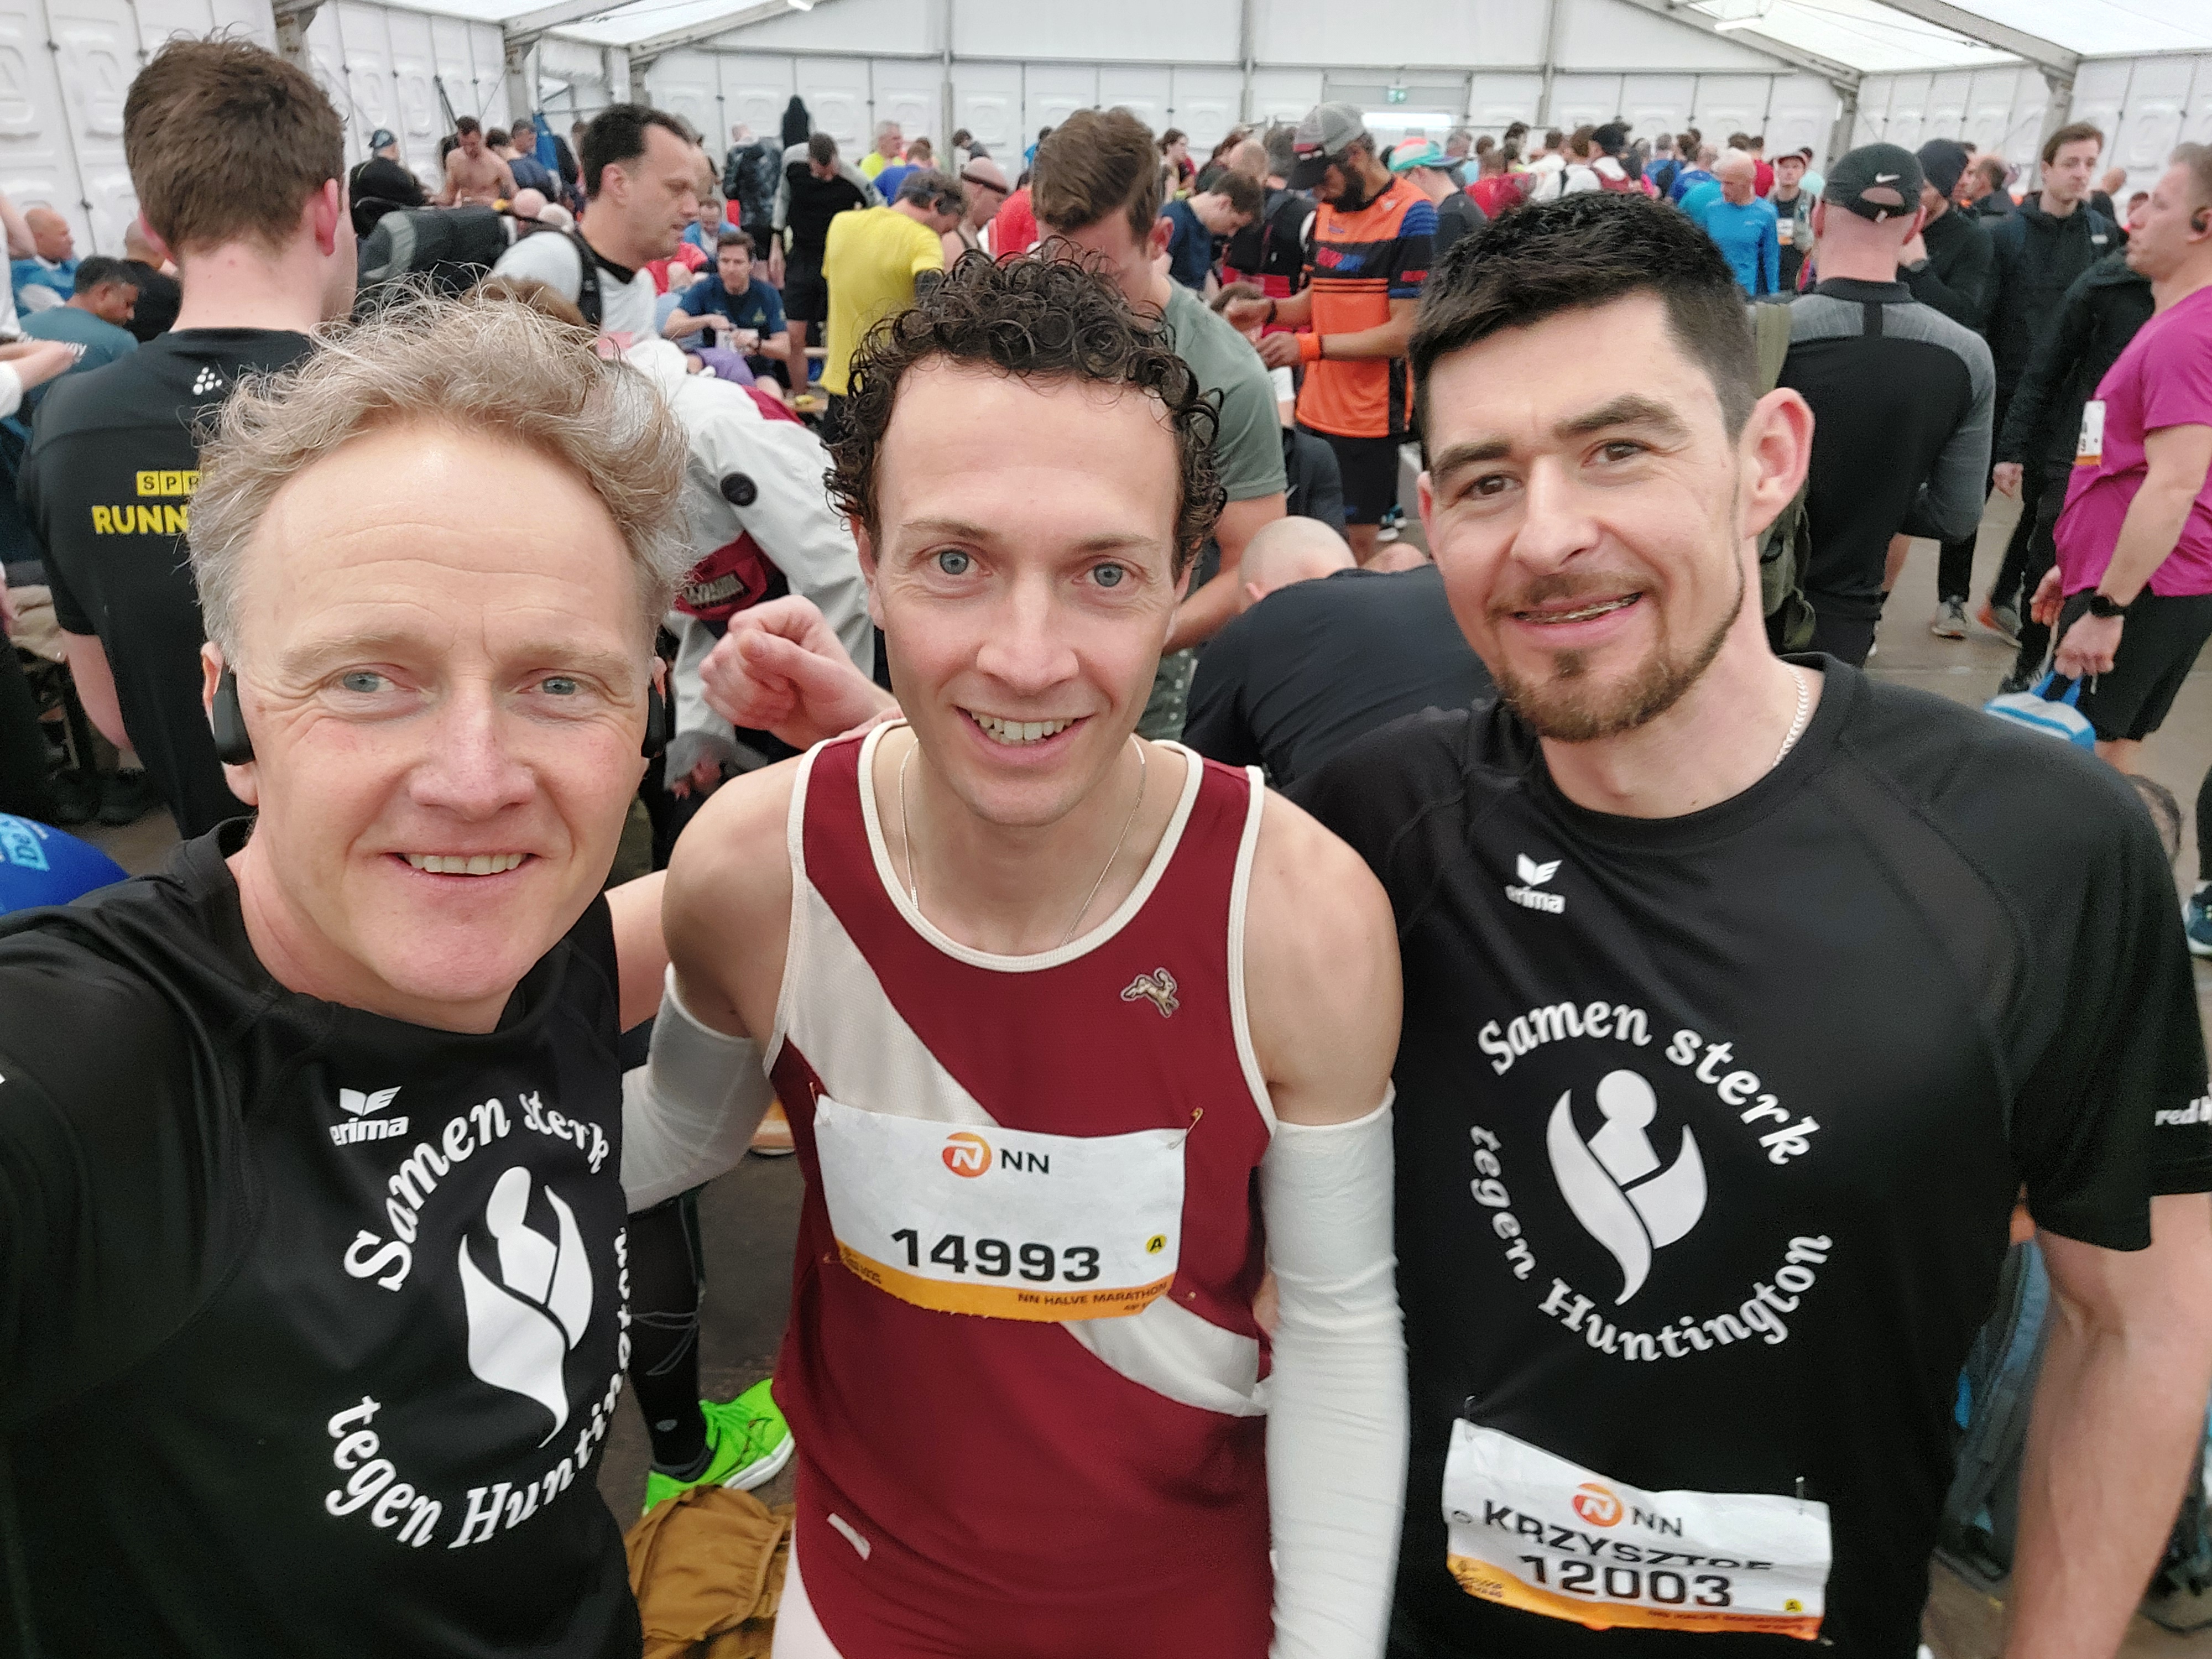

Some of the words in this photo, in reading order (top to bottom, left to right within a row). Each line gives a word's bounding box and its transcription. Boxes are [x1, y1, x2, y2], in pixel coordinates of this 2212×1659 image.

[92, 505, 189, 534] RUNN
[1505, 885, 1566, 914] erima
[1478, 1001, 1652, 1076] Samen
[1665, 1029, 1820, 1165] sterk
[329, 1117, 409, 1146] erima
[1001, 1149, 1050, 1174] NN
[344, 1098, 511, 1291] Samen
[519, 1091, 609, 1174] sterk
[891, 1228, 1100, 1283] 14993
[1149, 1237, 1162, 1252] A
[1471, 1126, 1535, 1280] tegen
[1538, 1235, 1832, 1361] Huntington
[1018, 1292, 1040, 1303] NN
[1044, 1295, 1088, 1305] HALVE
[1093, 1281, 1168, 1303] MARATHON
[325, 1395, 442, 1547] tegen
[1632, 1506, 1683, 1537] NN
[1519, 1555, 1731, 1607] 12003
